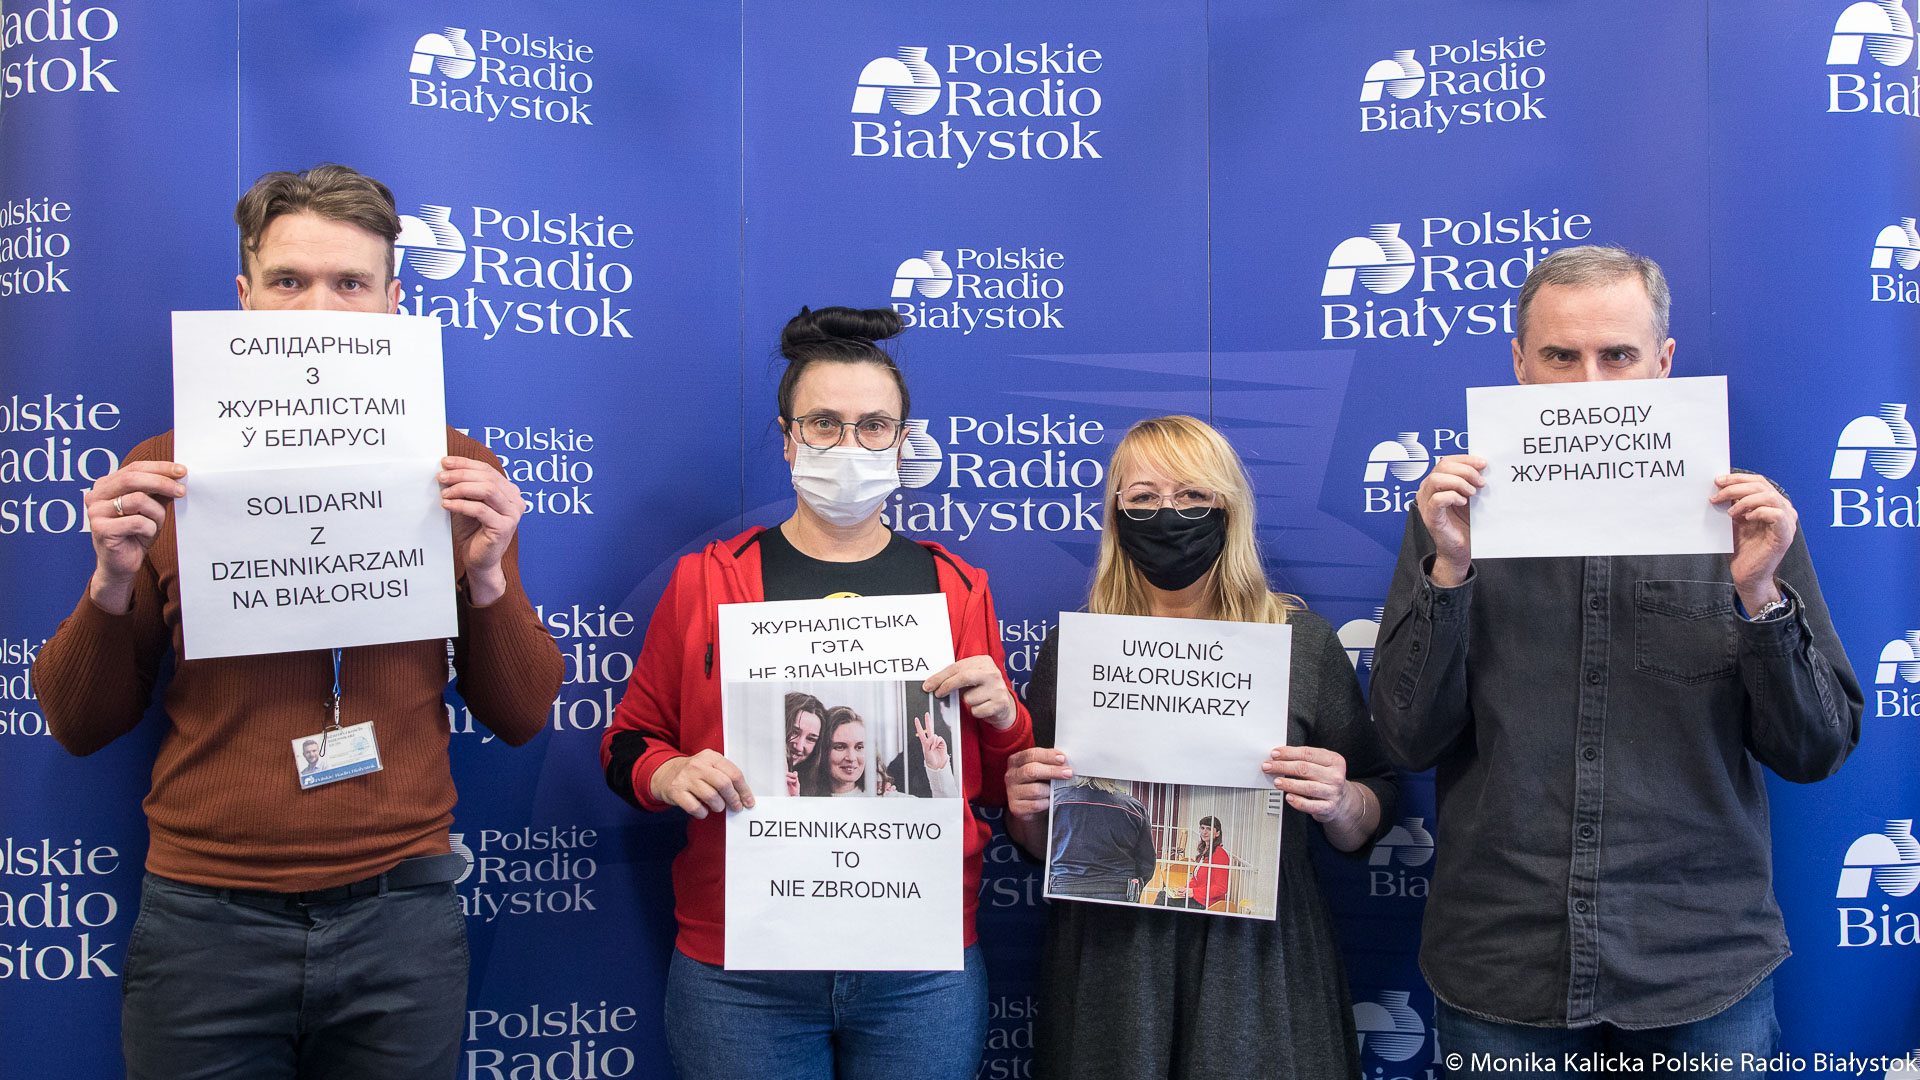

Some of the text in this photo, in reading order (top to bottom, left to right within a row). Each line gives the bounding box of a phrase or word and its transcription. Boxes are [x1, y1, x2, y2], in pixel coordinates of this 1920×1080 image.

[0, 0, 120, 53] adio
[481, 30, 594, 63] Polskie
[947, 43, 1103, 75] Polskie
[1429, 35, 1547, 65] Polskie
[0, 47, 121, 99] stok
[480, 56, 593, 94] Radio
[1429, 63, 1546, 97] Radio
[410, 79, 593, 126] Białystok
[946, 79, 1102, 117] Radio
[1361, 92, 1547, 134] Białystok
[852, 120, 1103, 169] Białystok
[472, 207, 634, 249] Polskie
[1422, 209, 1592, 248] Polskie
[0, 227, 71, 263] adio
[957, 248, 1065, 270] Polskie
[0, 261, 72, 298] stok
[472, 246, 633, 294] Radio
[957, 272, 1064, 299] Radio
[892, 302, 1065, 335] Białystok
[230, 337, 391, 359] САЛІДАРНЫЯ
[307, 367, 320, 385] З
[218, 398, 406, 419] ЖУРНАЛІСТАМІ
[1541, 405, 1652, 427] СВАБОДУ
[242, 427, 385, 448] Ў БЕЛАРУСІ
[484, 427, 595, 454] Polskie
[949, 414, 1105, 446] Polskie
[1524, 433, 1672, 455] БЕЛАРУСКІМ
[948, 450, 1104, 489] Radio
[1511, 460, 1685, 483] ЖУРНАЛІСТАМ
[247, 491, 383, 517] SOLIDARNI
[311, 527, 326, 546] Z
[211, 548, 426, 582] DZIENNIKARZAMI
[233, 579, 409, 610] NA BIAŁORUSI
[751, 615, 919, 635] ЖУРНАЛІСТЫКА
[998, 619, 1058, 643] lski
[812, 640, 864, 655] ГЭТА
[1123, 640, 1224, 662] UWOLNIĆ
[1093, 664, 1253, 692] BIAŁORUSKICH
[1093, 690, 1252, 718] DZIENNIKARZY
[480, 826, 597, 852] Polskie
[750, 821, 942, 840] DZIENNIKARSTWO
[479, 853, 597, 884] Radio
[832, 851, 860, 869] TO
[771, 880, 922, 899] NIE ZBRODNIA
[468, 1001, 637, 1041] Polskie
[466, 1040, 635, 1080] Radio
